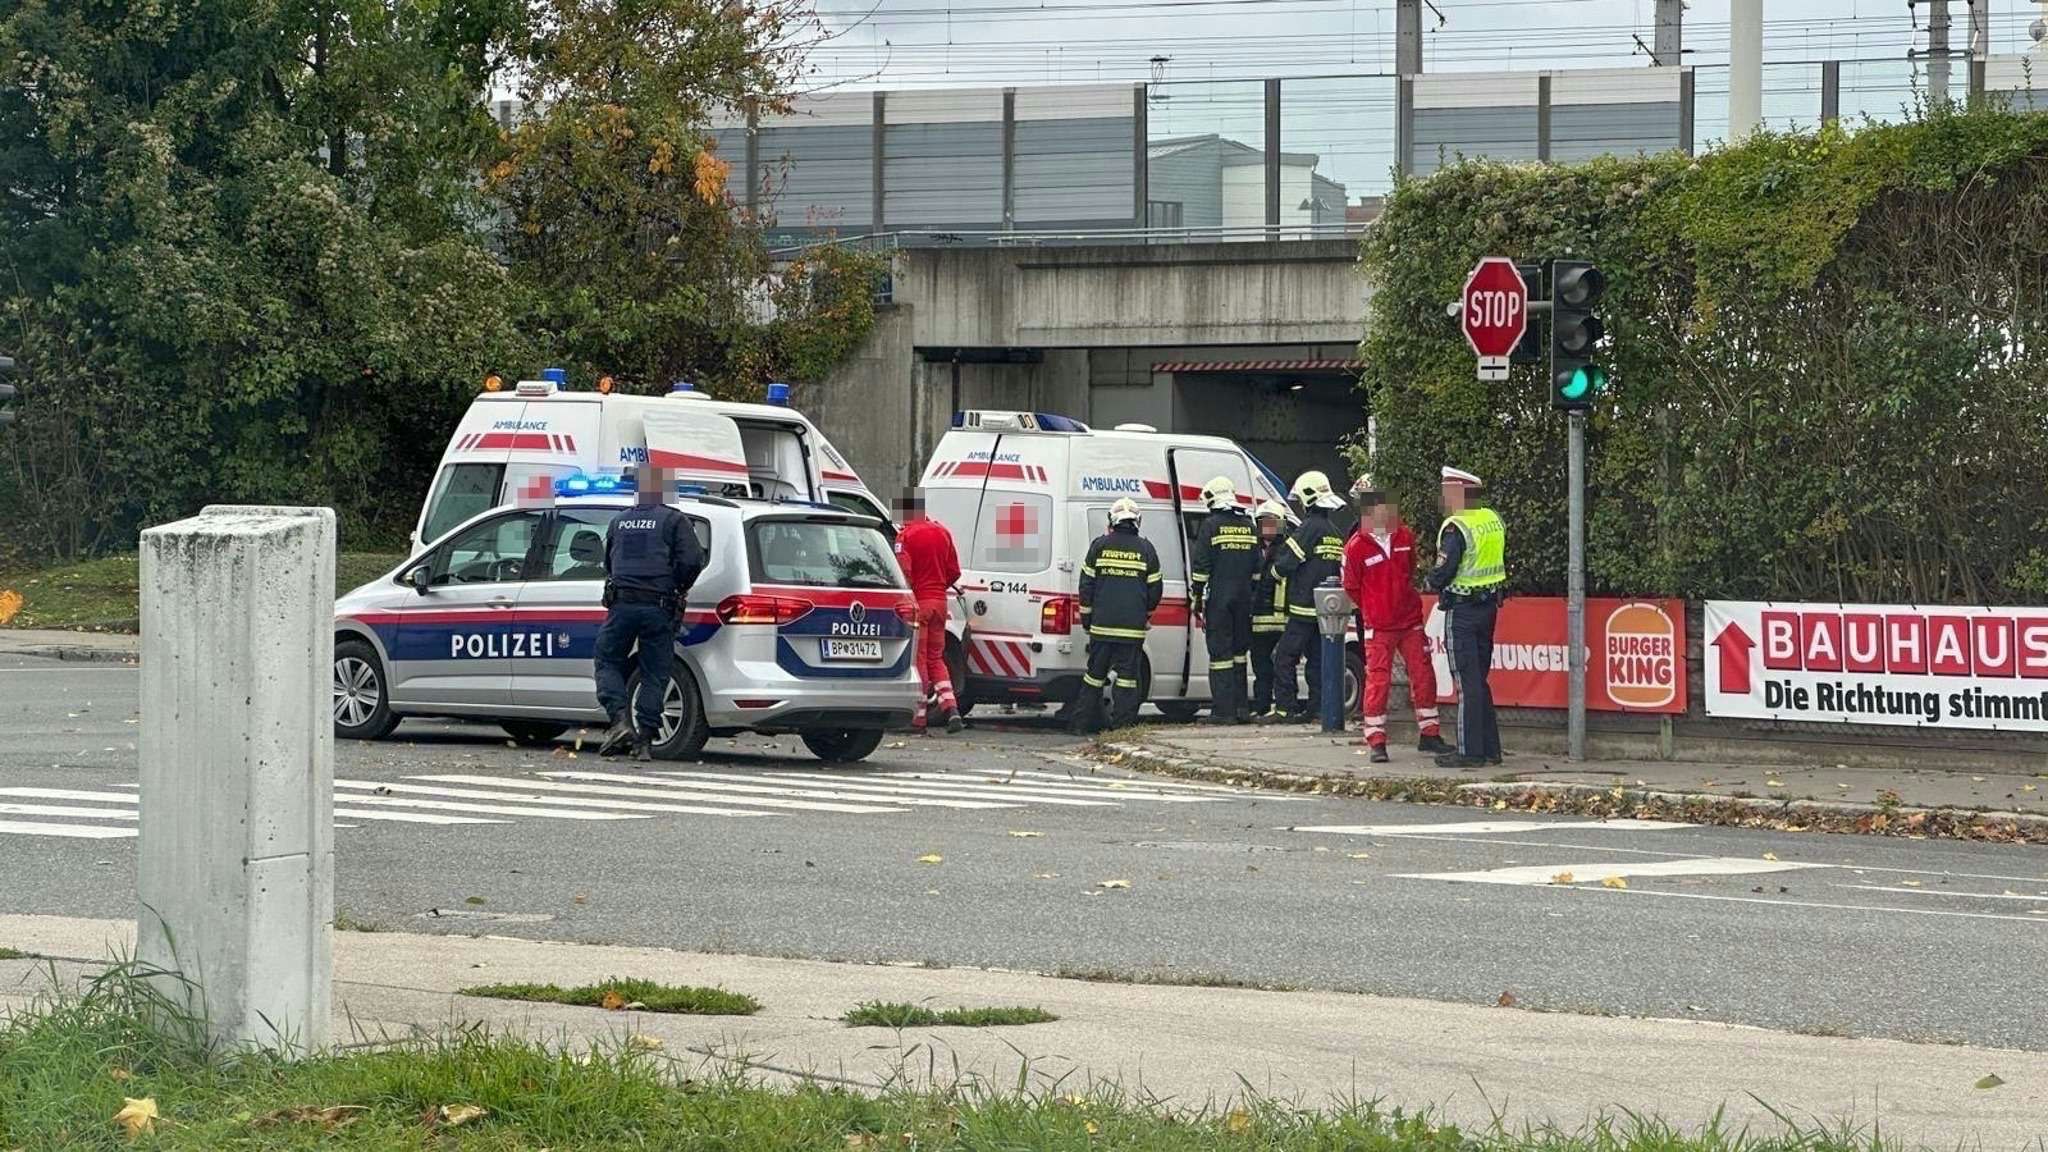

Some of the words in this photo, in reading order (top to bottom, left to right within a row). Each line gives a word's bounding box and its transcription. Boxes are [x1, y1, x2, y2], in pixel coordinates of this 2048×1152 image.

[1470, 291, 1519, 327] STOP
[493, 421, 547, 430] AMBULANCE
[967, 451, 1021, 462] AMBULANCE
[1082, 477, 1141, 492] AMBULANCE
[618, 520, 656, 529] POLIZEI
[1007, 582, 1027, 593] 144
[832, 623, 880, 636] POLIZEI
[452, 633, 552, 657] POLIZEI
[1609, 637, 1671, 656] BURGER
[1768, 620, 2048, 667] BAUHAUS
[1609, 657, 1672, 685] KING
[1765, 680, 1809, 710] Die
[1817, 682, 1940, 722] Richtung
[1949, 686, 2048, 722] stimmt
